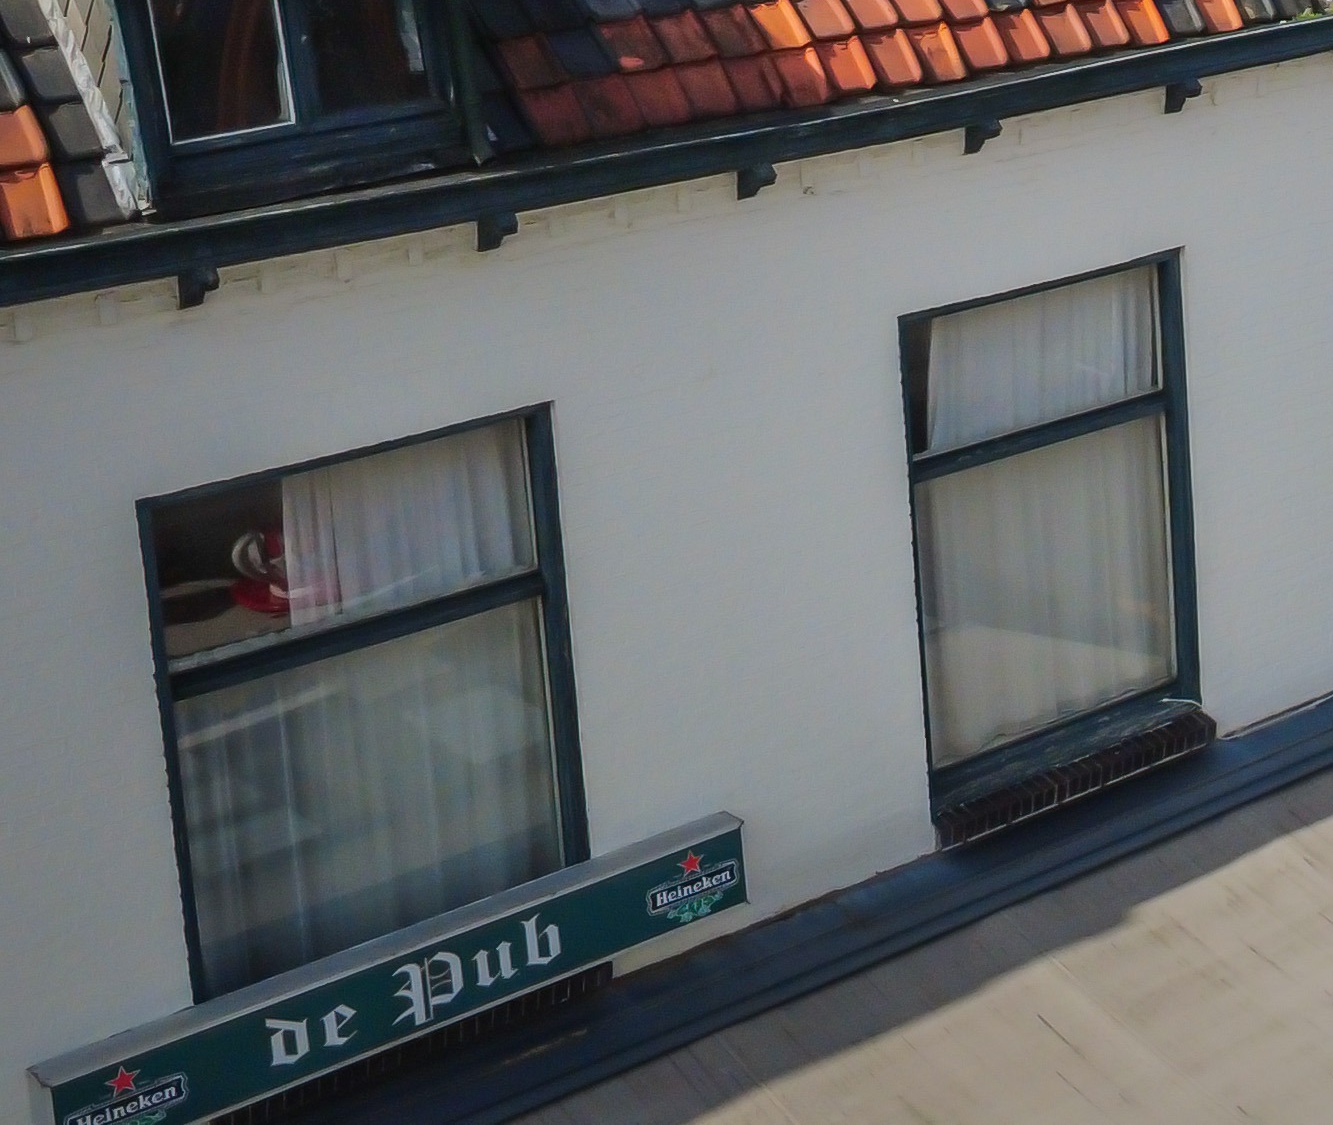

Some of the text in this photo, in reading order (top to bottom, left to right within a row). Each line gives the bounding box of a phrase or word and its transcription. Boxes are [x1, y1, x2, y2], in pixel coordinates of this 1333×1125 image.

[656, 870, 732, 907] Heineken
[265, 913, 562, 1067] de Pub
